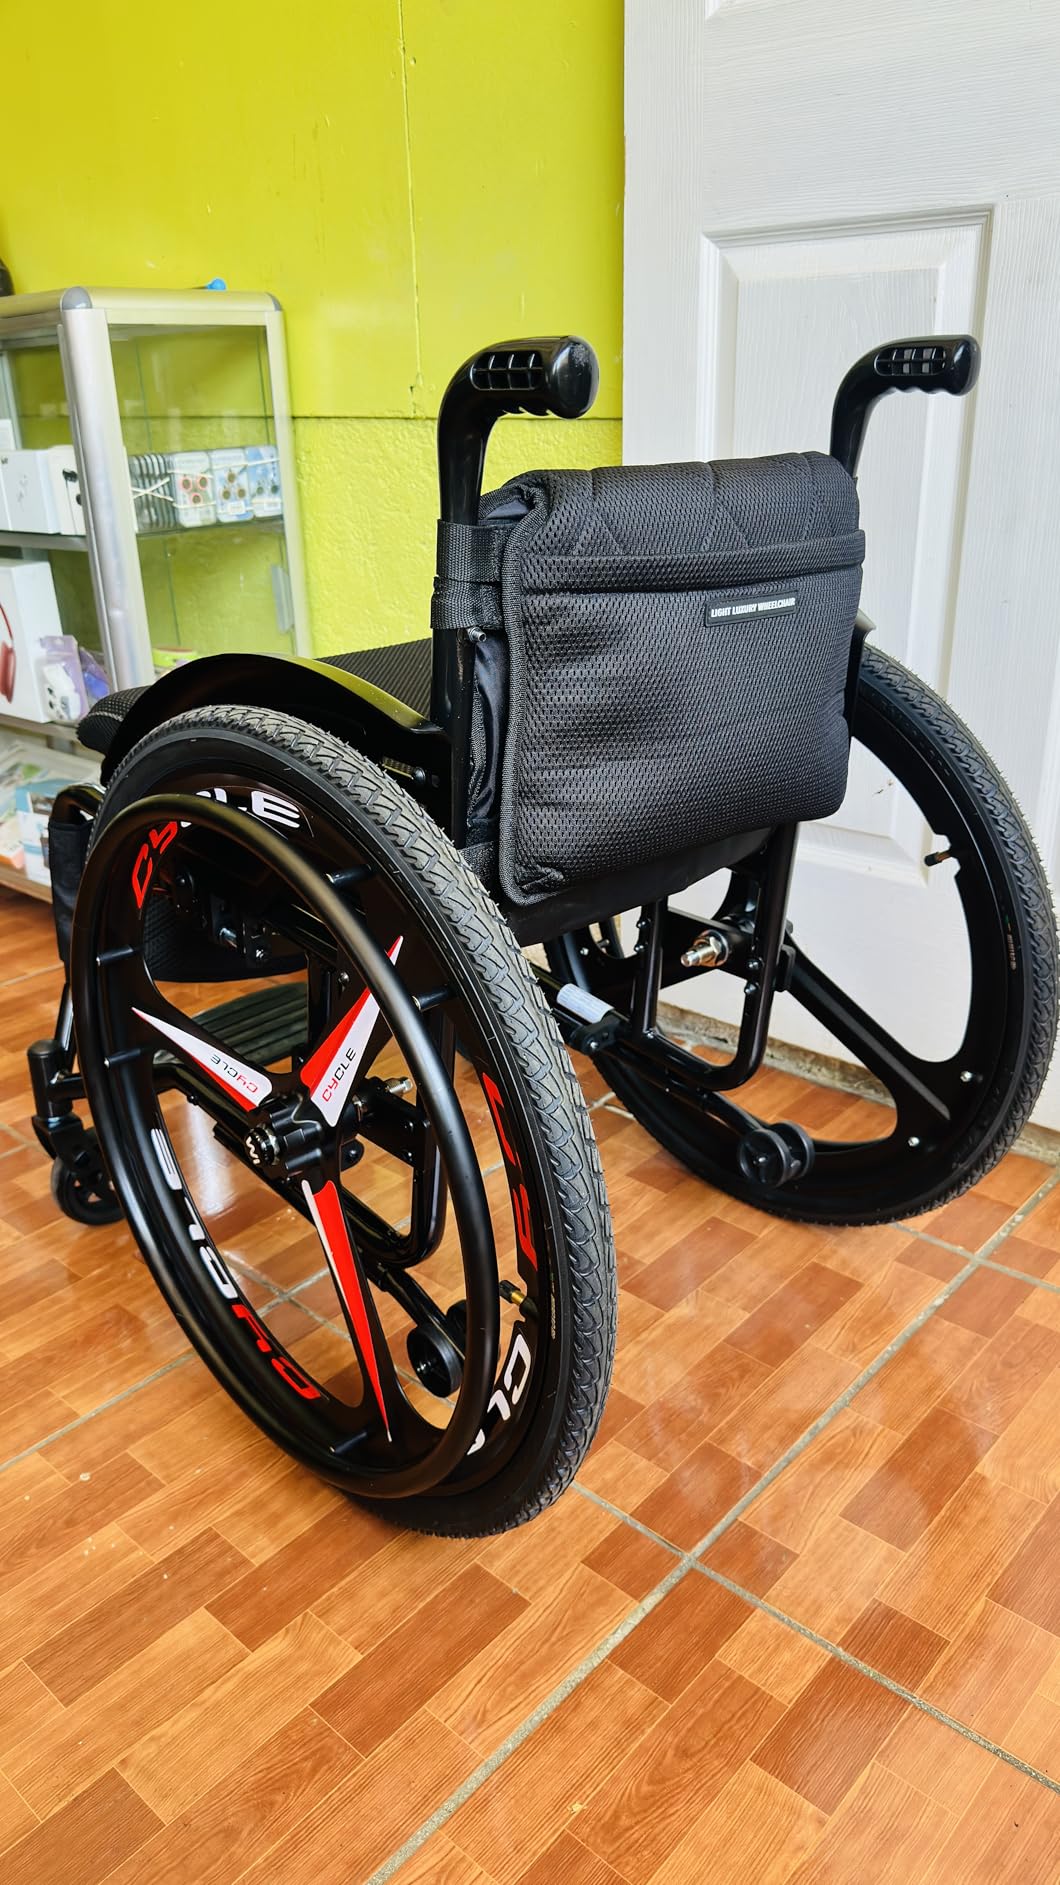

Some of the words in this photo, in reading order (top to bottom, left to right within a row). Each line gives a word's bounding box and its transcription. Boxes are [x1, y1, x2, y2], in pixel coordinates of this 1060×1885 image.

[710, 607, 732, 618] LIGHT
[731, 603, 758, 615] LUXURY
[757, 597, 796, 612] WHEELCHAIR
[210, 1053, 259, 1093] CYCLE
[321, 1047, 356, 1102] CYCLE
